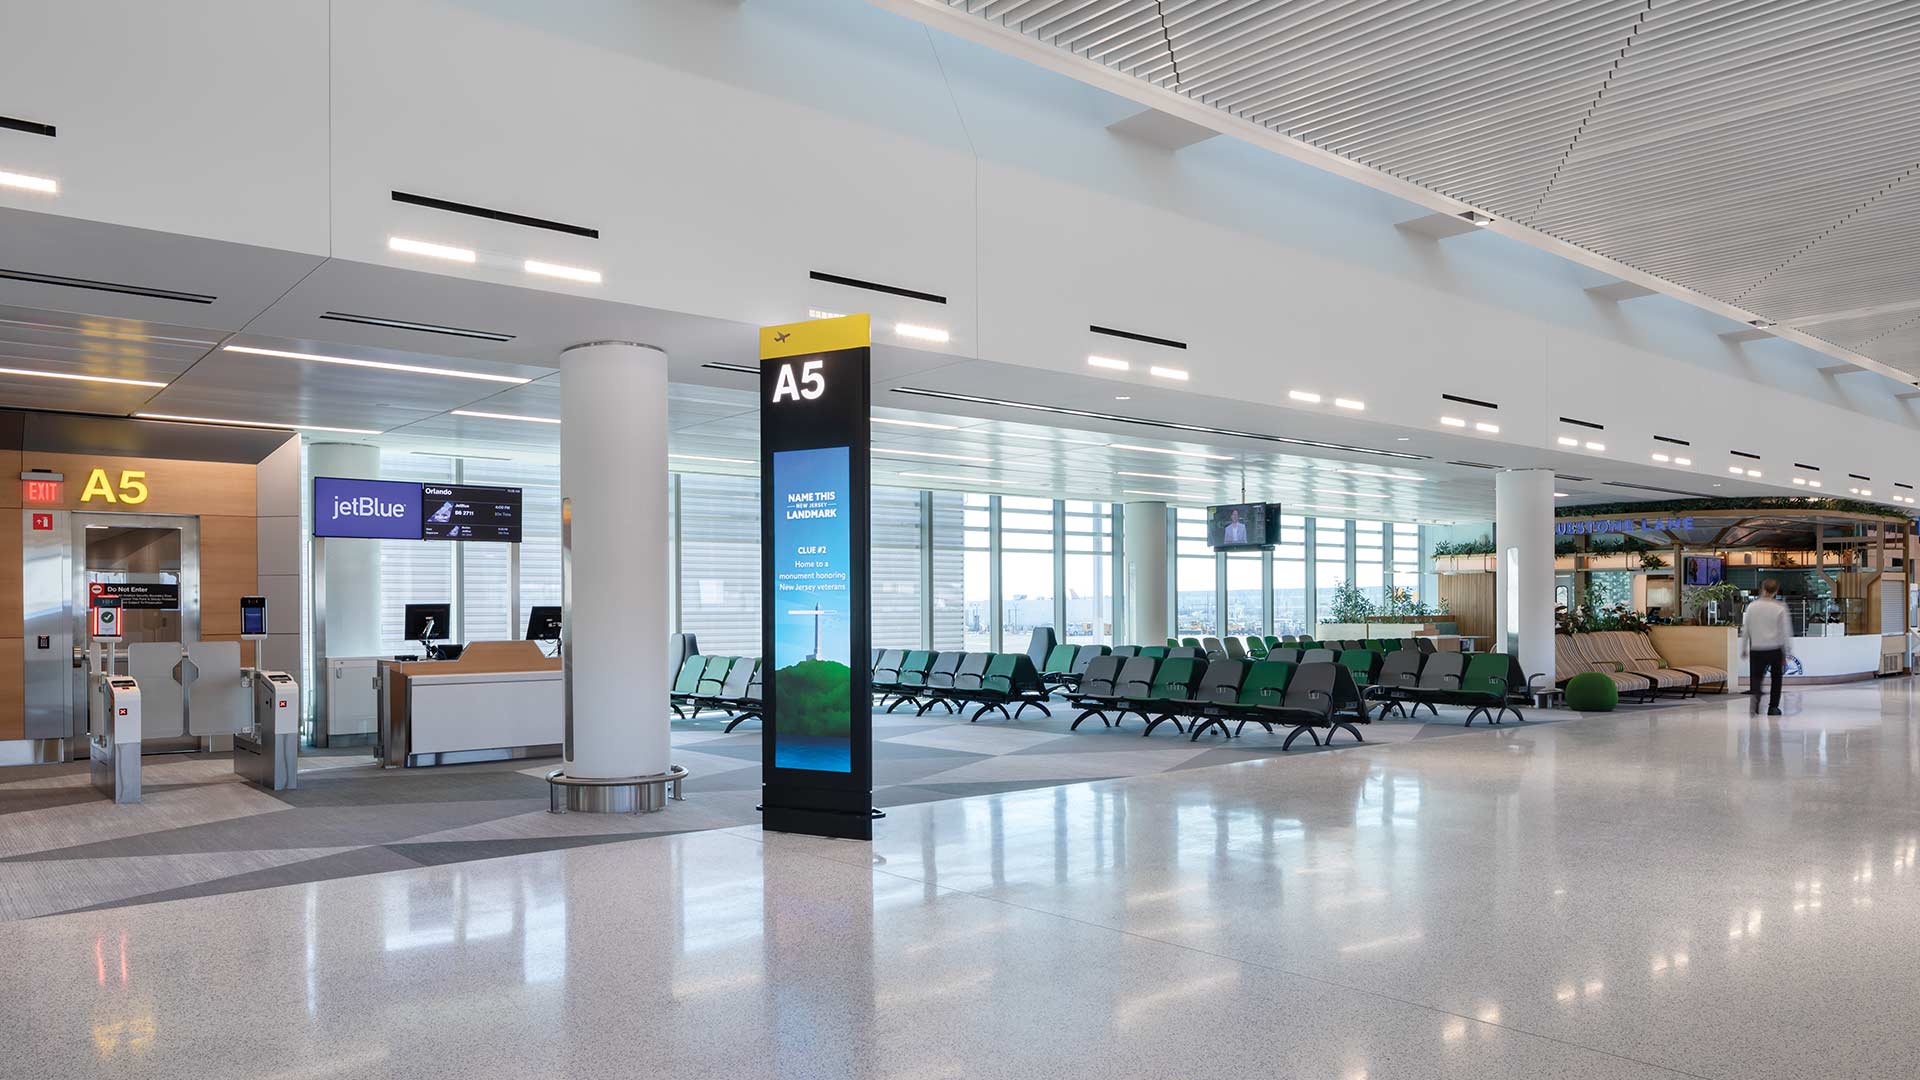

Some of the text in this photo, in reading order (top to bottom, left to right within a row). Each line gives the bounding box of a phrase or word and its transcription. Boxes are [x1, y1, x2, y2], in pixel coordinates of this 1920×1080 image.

[772, 360, 825, 403] A5
[29, 482, 57, 501] EXIT
[80, 468, 148, 504] A5
[425, 487, 452, 496] Orlando
[788, 492, 836, 502] NAME THIS
[332, 496, 404, 519] jetBlue
[786, 508, 837, 520] LANDMARK
[1555, 517, 1695, 535] UESTONE LANE
[797, 546, 827, 555] CLUE #2
[816, 572, 846, 580] honoring
[795, 584, 816, 592] Jersey
